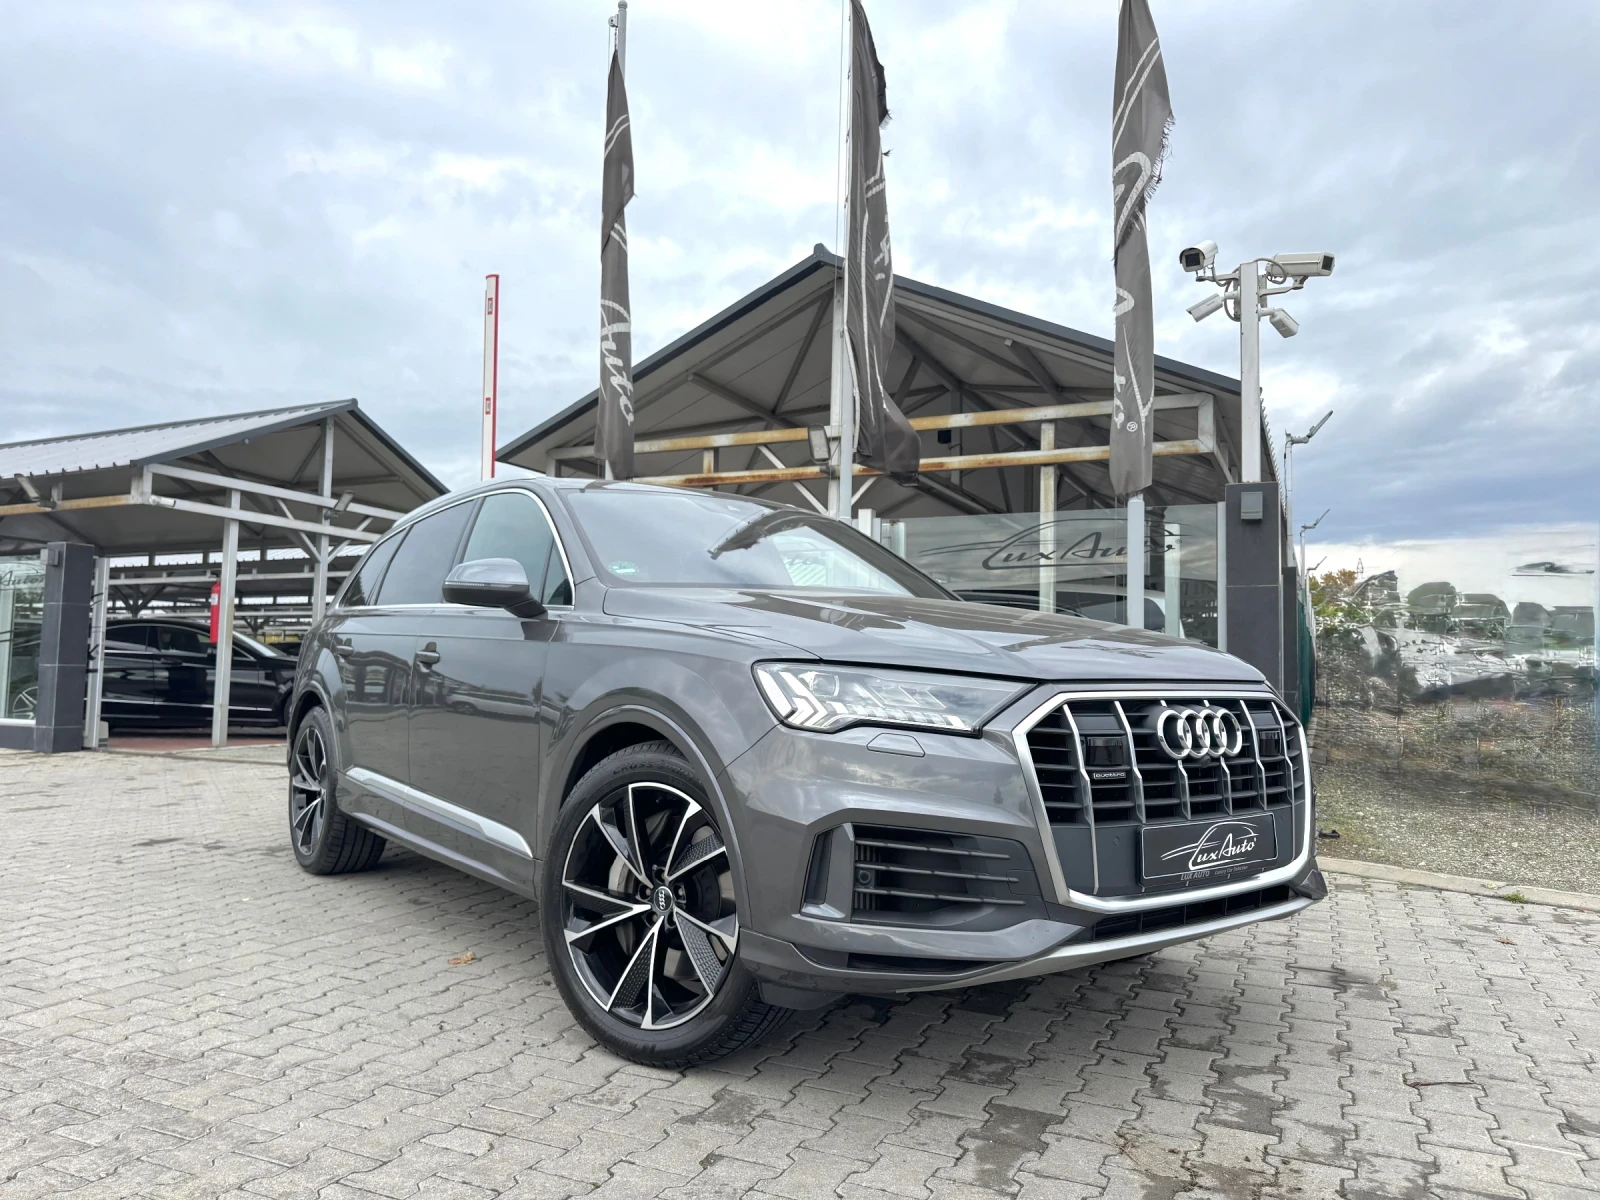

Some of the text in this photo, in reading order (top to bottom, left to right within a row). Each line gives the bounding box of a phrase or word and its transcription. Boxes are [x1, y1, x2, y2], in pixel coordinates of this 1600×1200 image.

[600, 299, 634, 427] Auto
[1219, 833, 1255, 859] Auto
[1180, 873, 1193, 881] LUX
[1193, 870, 1210, 879] AUTO
